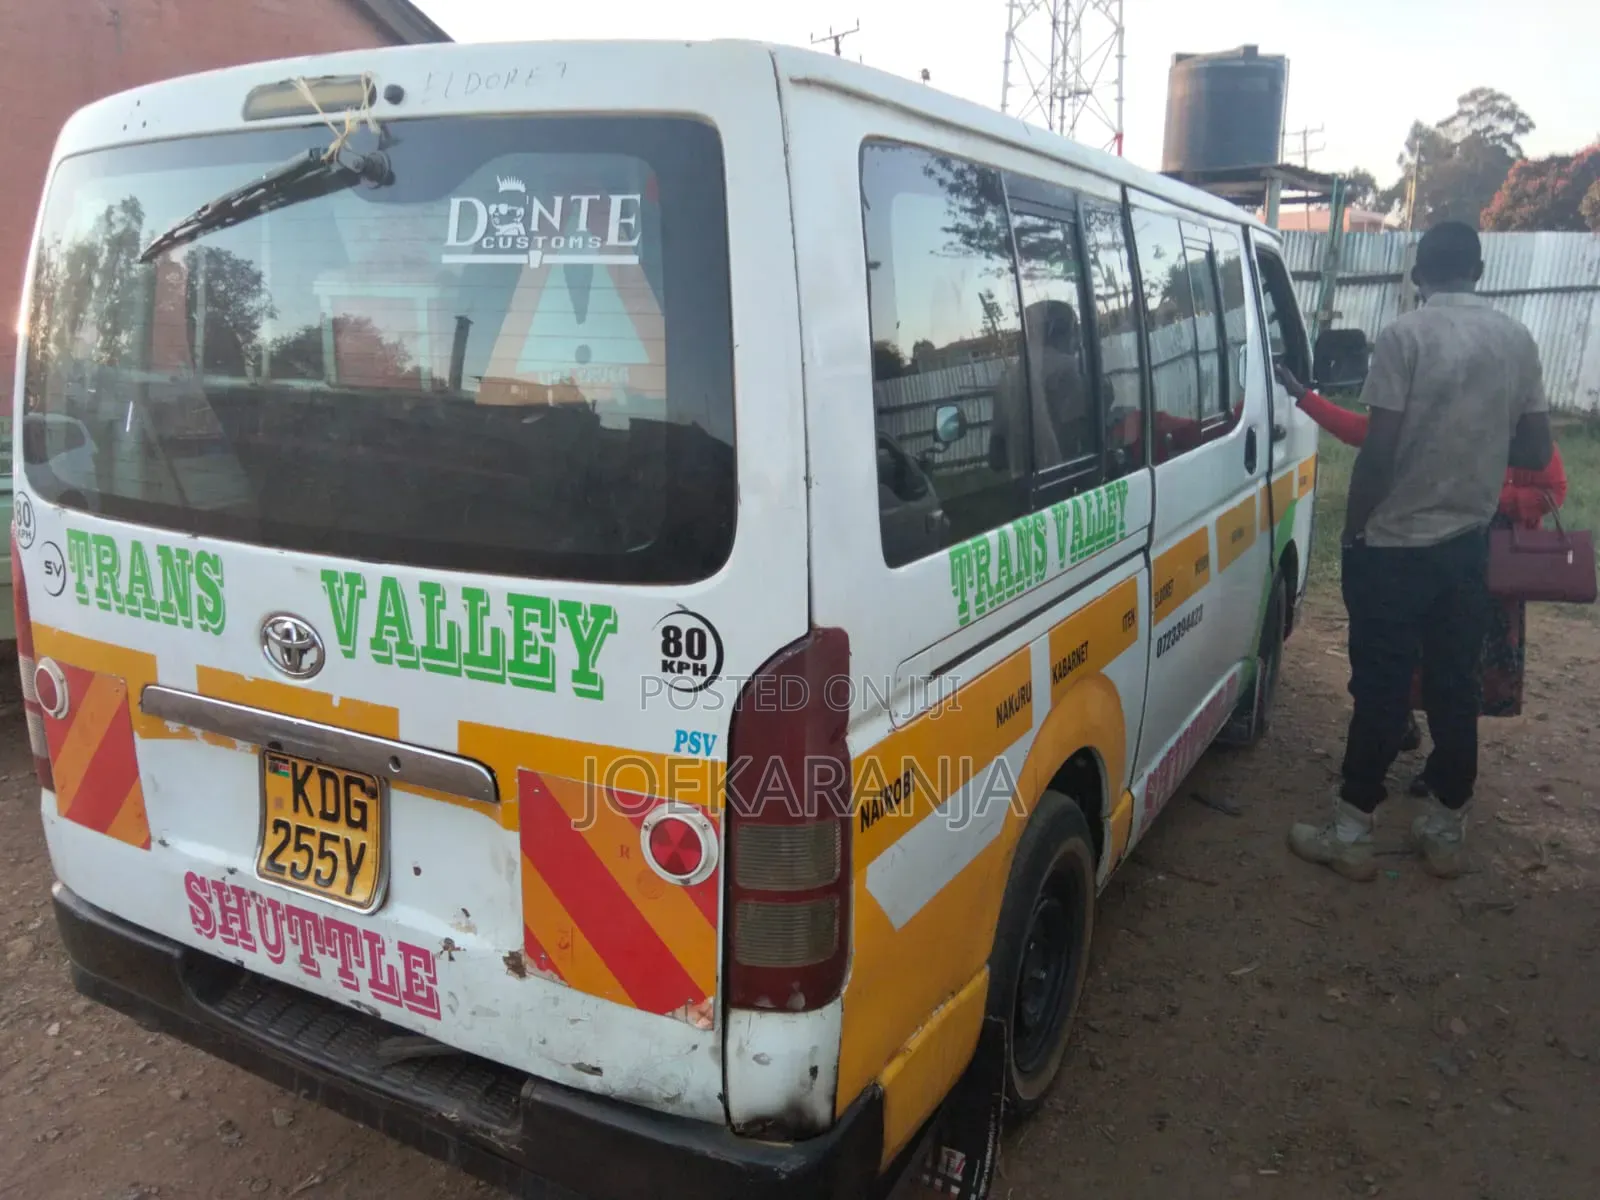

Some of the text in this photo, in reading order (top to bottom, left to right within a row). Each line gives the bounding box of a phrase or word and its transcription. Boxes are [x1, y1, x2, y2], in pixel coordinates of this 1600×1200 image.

[445, 194, 641, 248] DNTE
[481, 235, 602, 249] CUSTOMS
[949, 479, 1129, 626] TRANS VALLEY
[66, 527, 618, 701] TRANS VALLEY
[1121, 608, 1136, 633] ITEN
[661, 625, 707, 660] 80
[1052, 640, 1089, 685] KABARNET
[661, 660, 708, 677] KPH
[996, 681, 1033, 728] NAKURU
[674, 728, 718, 757] PSV
[291, 761, 369, 832] KDG
[860, 767, 916, 833] NAIROBI
[266, 819, 366, 896] 255Y
[184, 871, 441, 1021] SHUTTLE
